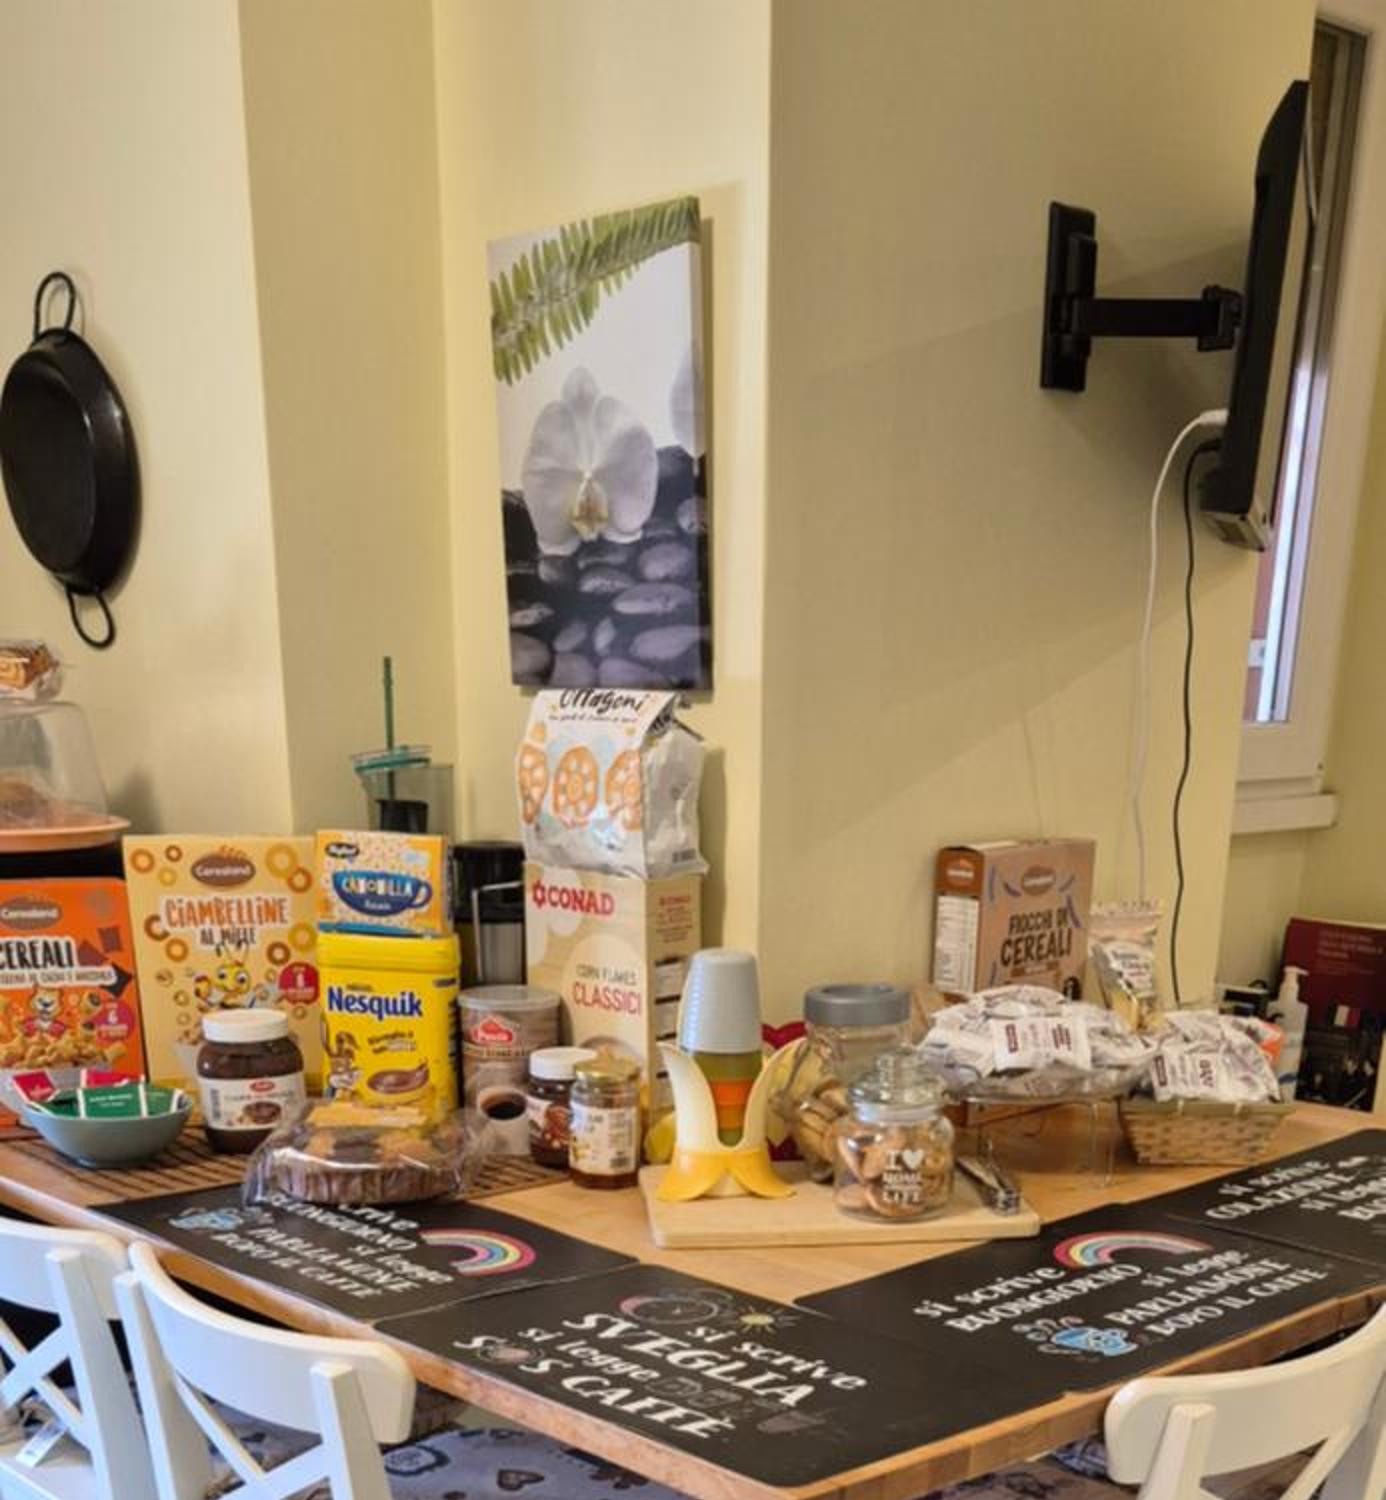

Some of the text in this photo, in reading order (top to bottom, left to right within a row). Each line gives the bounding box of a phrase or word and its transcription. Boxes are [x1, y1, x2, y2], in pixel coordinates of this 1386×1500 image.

[547, 885, 616, 917] CONAD
[1008, 908, 1053, 935] FIOCCHI
[1000, 928, 1072, 968] CEREALI
[327, 985, 424, 1022] Nesquik
[943, 1262, 1143, 1333] BUONGIORNO
[953, 1266, 1067, 1305] scrive
[1103, 1257, 1292, 1326] PARLIAMONE
[517, 1326, 661, 1384] si legge
[562, 1311, 816, 1409] SVEGLIA
[686, 1324, 868, 1391] si scrive
